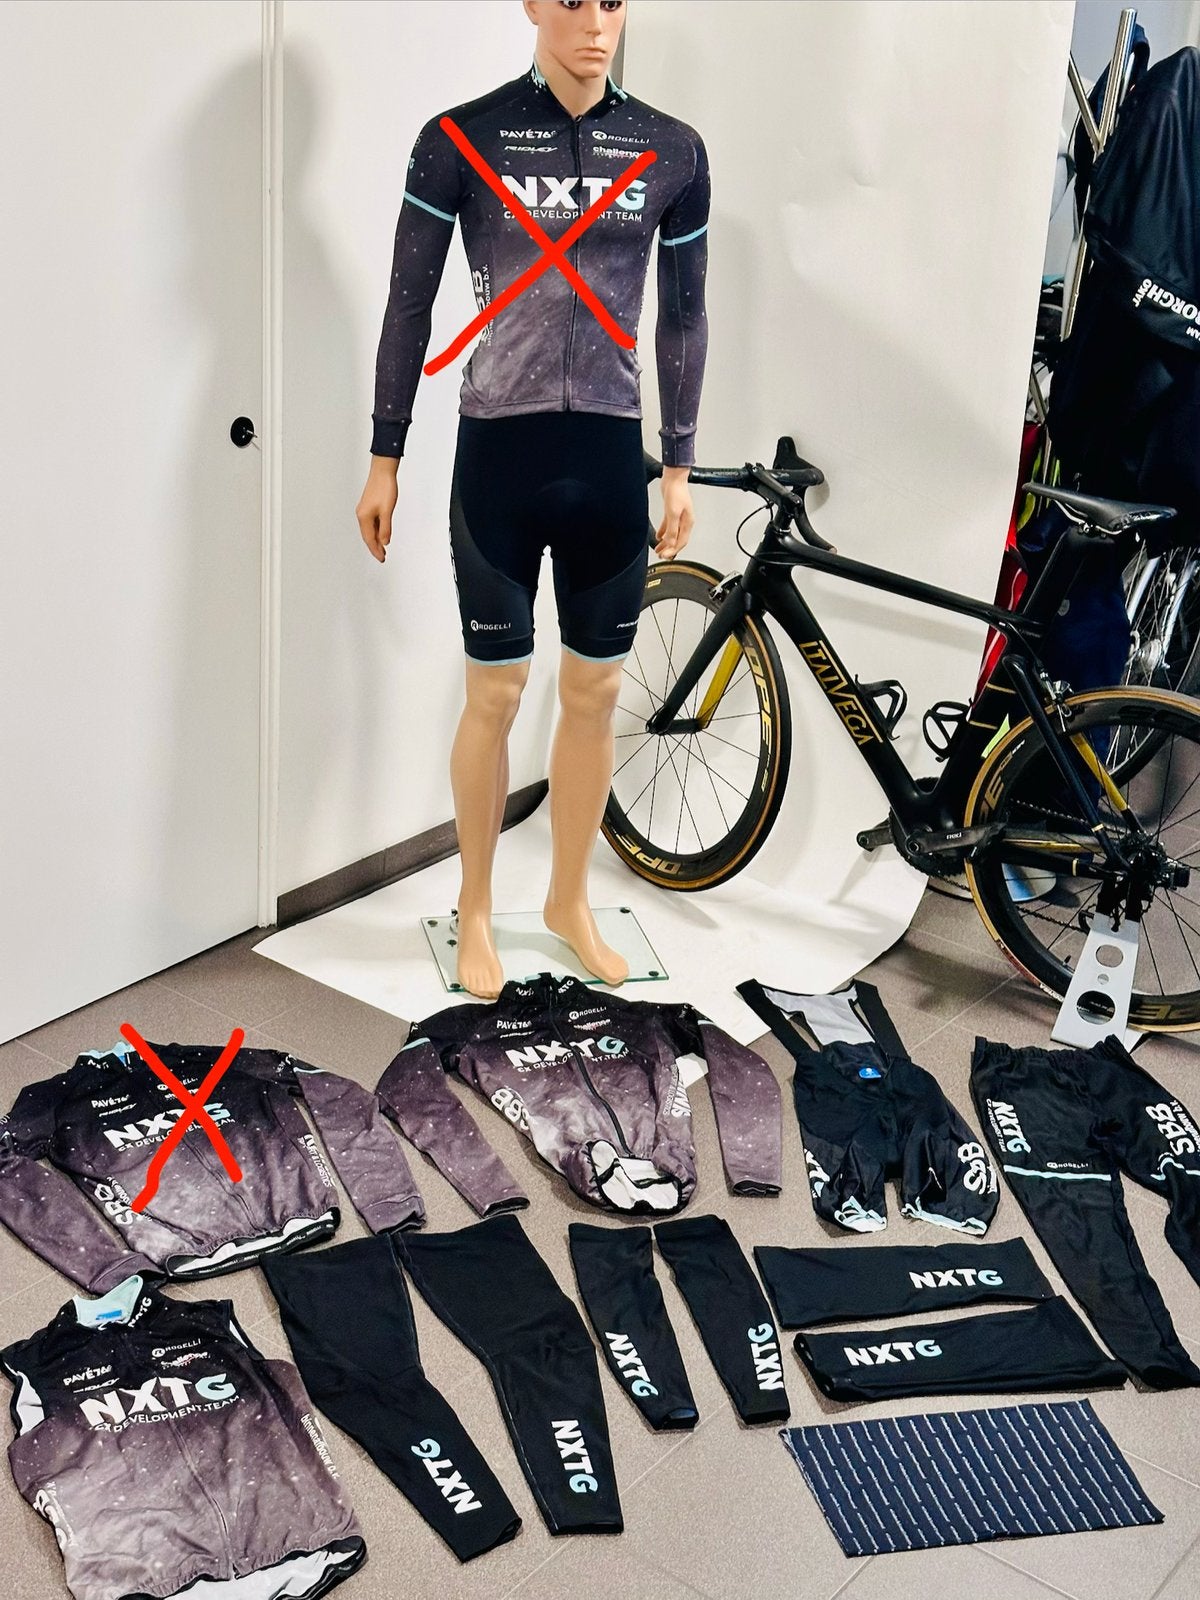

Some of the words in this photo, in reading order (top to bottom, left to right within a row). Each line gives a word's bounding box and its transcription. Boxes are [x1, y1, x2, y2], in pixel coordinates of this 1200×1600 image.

[607, 135, 650, 144] ROGELLI
[501, 175, 648, 211] NXTG
[527, 210, 613, 221] DEVELOPNT
[615, 211, 642, 222] TEAM
[1132, 278, 1153, 308] JAKO
[1186, 326, 1200, 341] AM
[479, 622, 511, 631] ROGELLI
[799, 640, 878, 747] ITALVEGA
[579, 1006, 607, 1016] ROGELLI
[505, 1035, 625, 1067] NXTG
[533, 1052, 604, 1069] DEVELOPNT
[606, 1047, 630, 1060] TEAM
[992, 1100, 1032, 1153] NXTG
[909, 1268, 1004, 1289] NXTG
[165, 1339, 201, 1351] ROGELLI
[748, 1323, 784, 1391] NXTG
[843, 1339, 943, 1367] NXTG
[605, 1331, 658, 1397] NXTG
[79, 1373, 236, 1426] NXTG
[114, 1405, 202, 1433] DEVELOPMENT
[206, 1395, 239, 1412] TEAM
[551, 1419, 598, 1493] NXTG
[411, 1438, 482, 1515] NXTG
